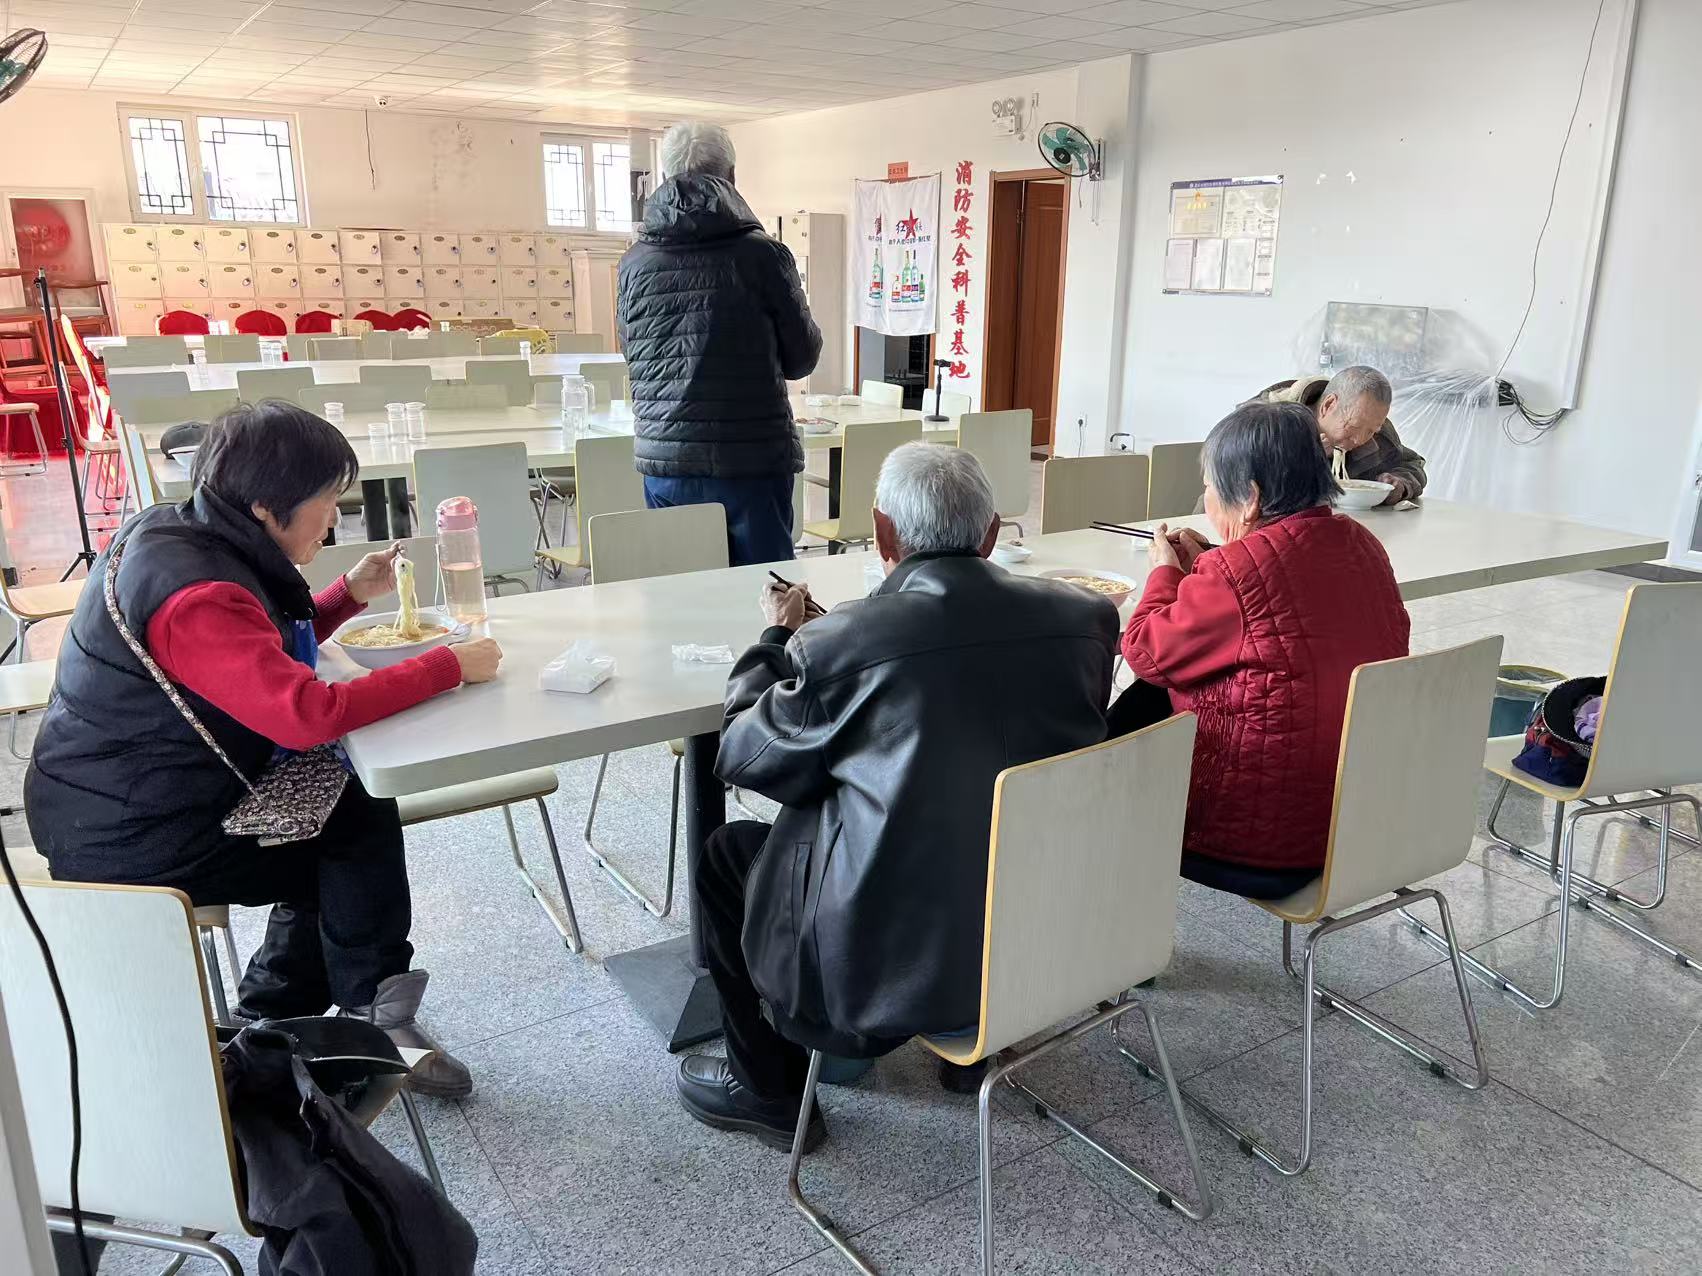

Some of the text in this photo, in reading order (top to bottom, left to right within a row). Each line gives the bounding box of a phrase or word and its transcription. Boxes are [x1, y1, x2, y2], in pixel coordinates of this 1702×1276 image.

[949, 160, 974, 380] 消防安全科普基地
